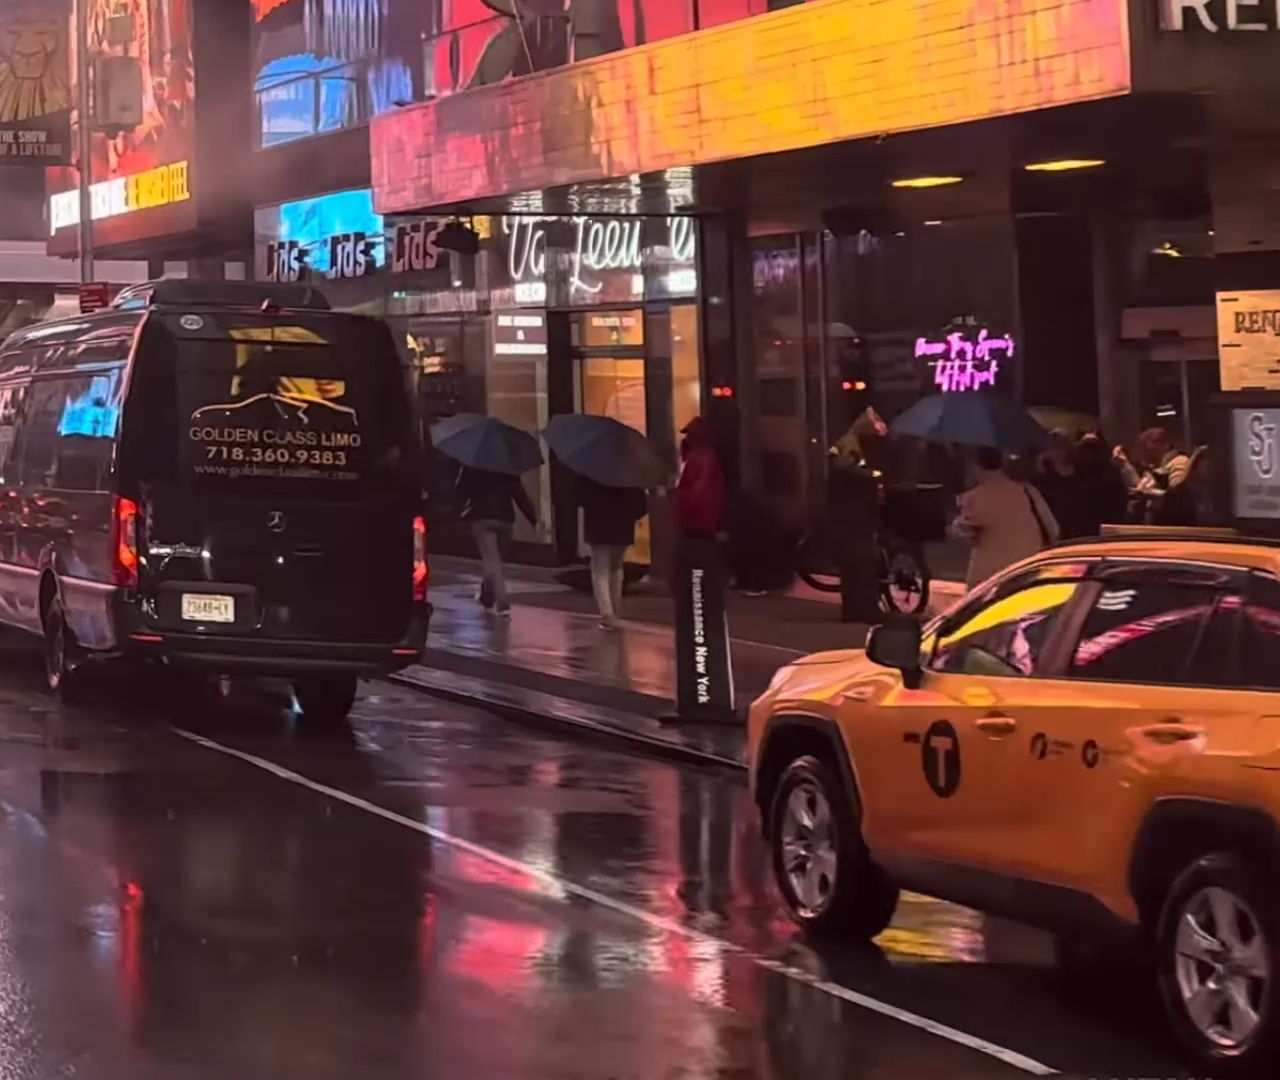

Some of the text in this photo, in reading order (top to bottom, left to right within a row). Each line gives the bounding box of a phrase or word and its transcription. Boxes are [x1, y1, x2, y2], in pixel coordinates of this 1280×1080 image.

[327, 232, 367, 280] Lids
[391, 220, 440, 272] Lids
[190, 426, 362, 448] GOLDEN CLASS LIMO
[205, 445, 347, 466] 718.360.9383
[691, 568, 711, 705] Renaissance New York
